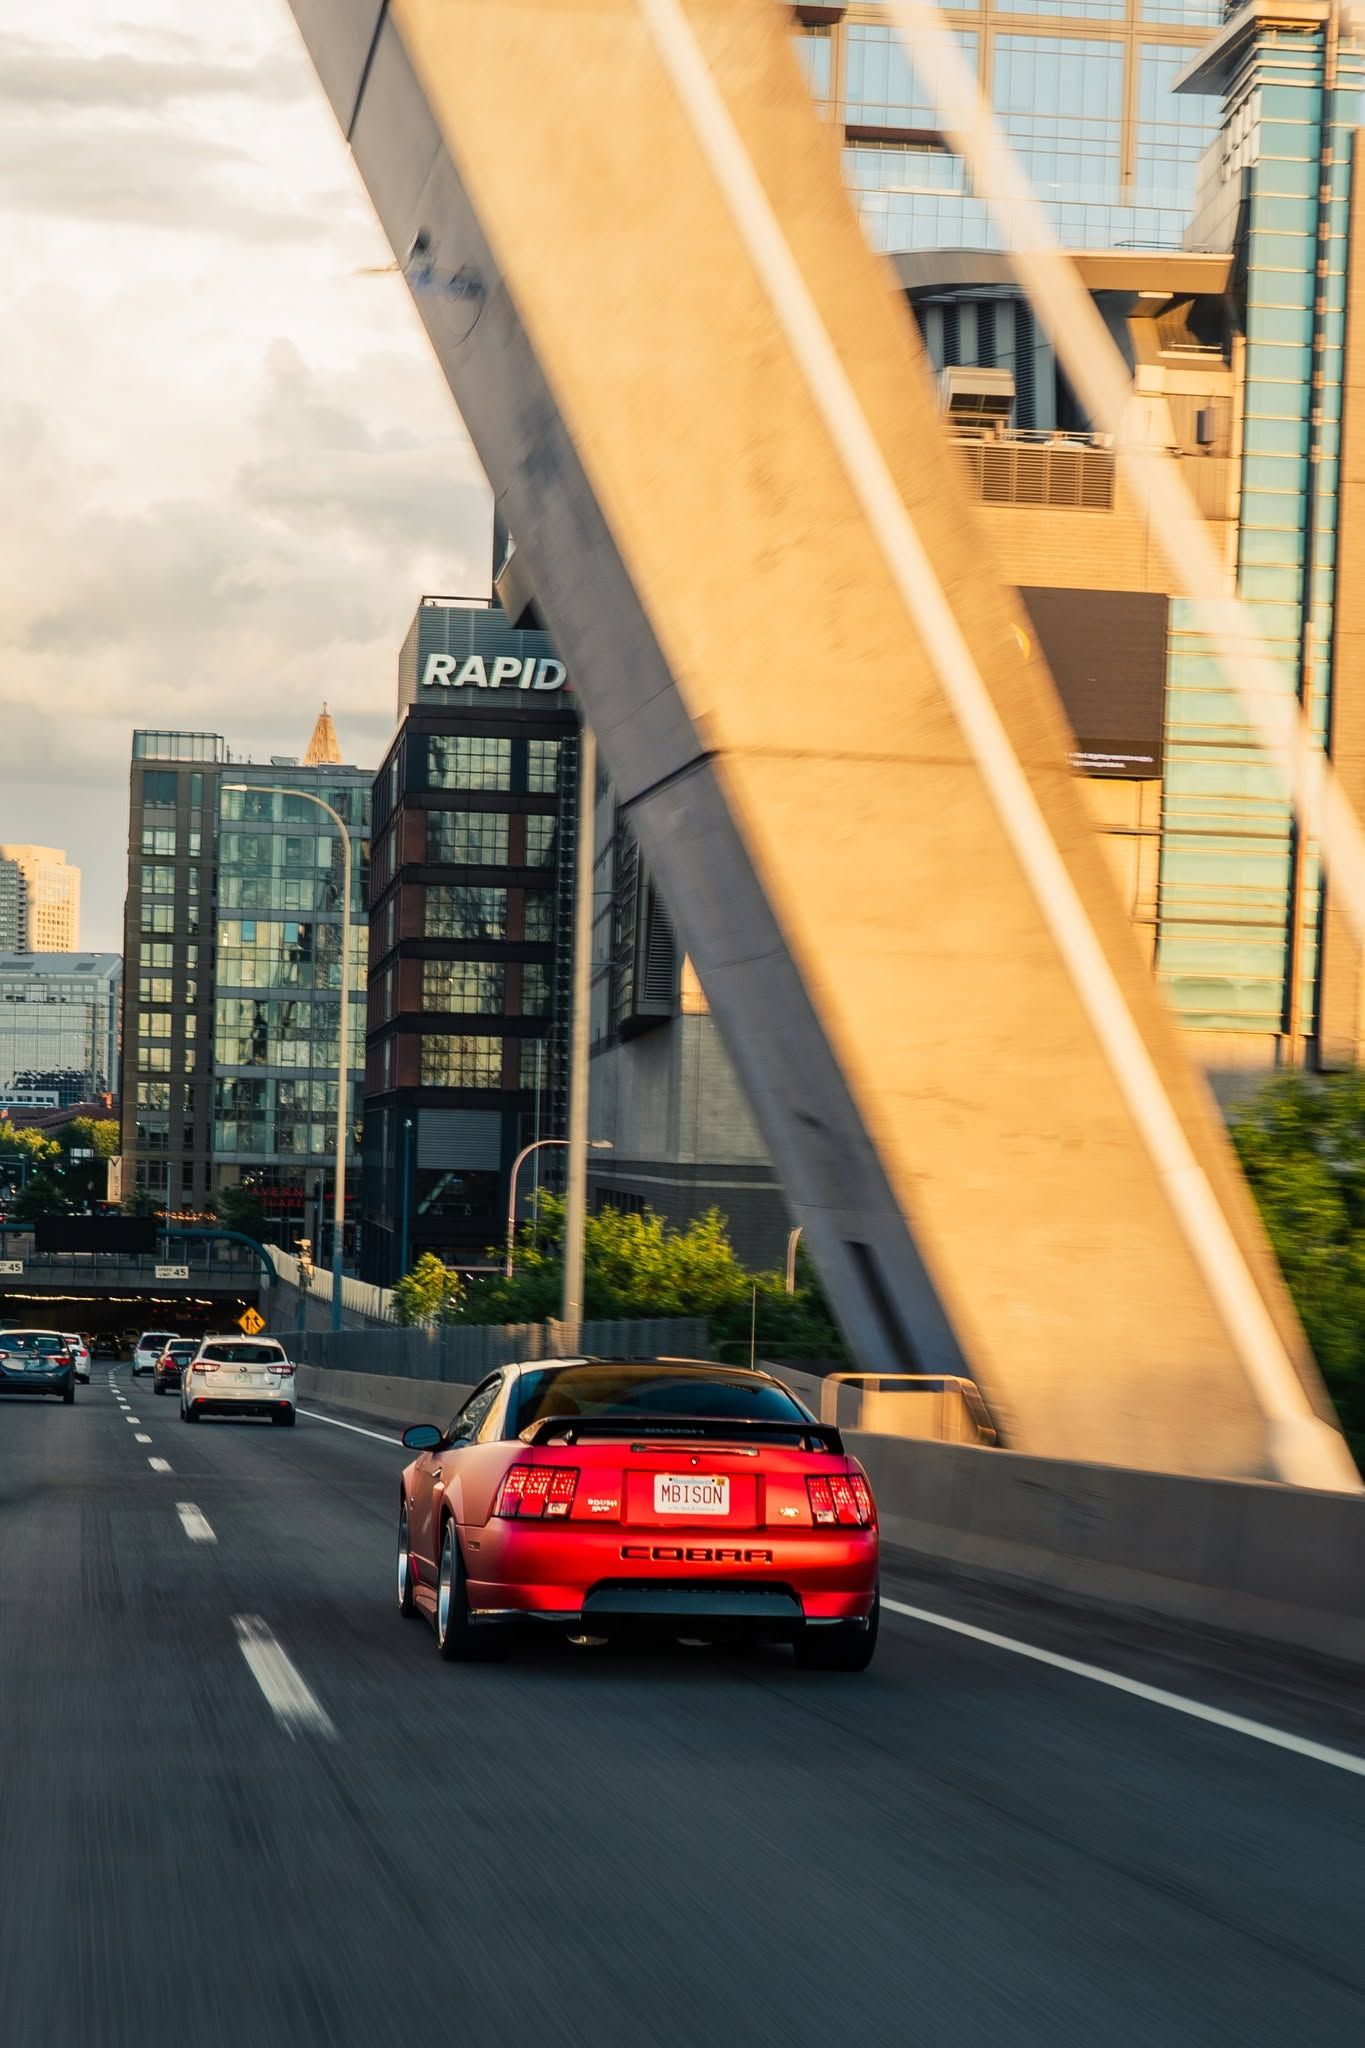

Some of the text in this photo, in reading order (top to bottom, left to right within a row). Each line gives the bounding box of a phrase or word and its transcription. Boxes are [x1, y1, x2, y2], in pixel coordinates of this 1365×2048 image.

[422, 653, 575, 690] RAPID
[250, 1187, 304, 1198] AVERN
[8, 1263, 21, 1271] 45
[173, 1268, 186, 1276] 45
[661, 1484, 722, 1504] MBISON
[587, 1498, 618, 1507] ROUSH
[620, 1545, 773, 1564] COBRA
